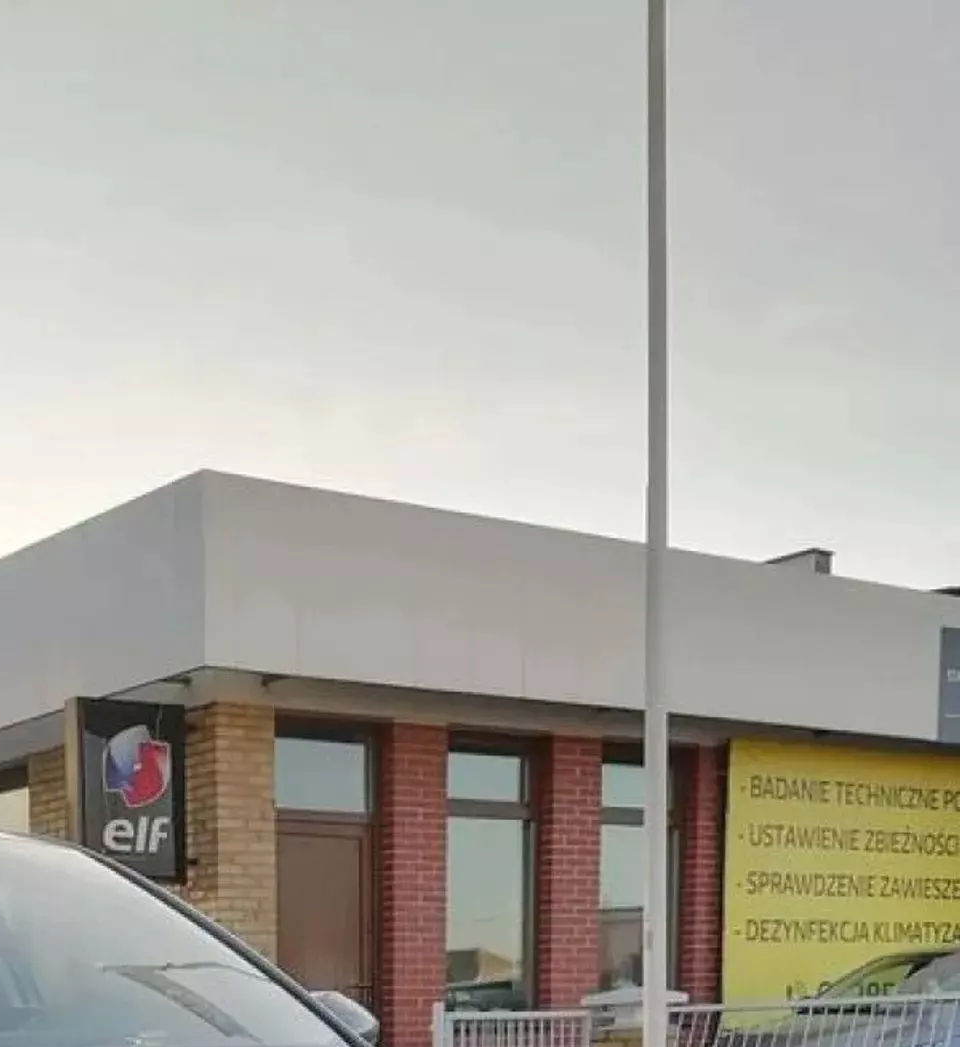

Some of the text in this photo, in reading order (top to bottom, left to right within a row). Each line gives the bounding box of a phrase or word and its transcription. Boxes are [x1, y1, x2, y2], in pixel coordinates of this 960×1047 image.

[749, 775, 831, 804] BADANIE
[835, 781, 939, 811] TECHNICZNE
[103, 816, 171, 854] elf
[748, 823, 861, 852] USTAWIENIE
[746, 870, 874, 898] SPRAWDZENIE
[745, 918, 869, 944] DEZYNFEKCJA
